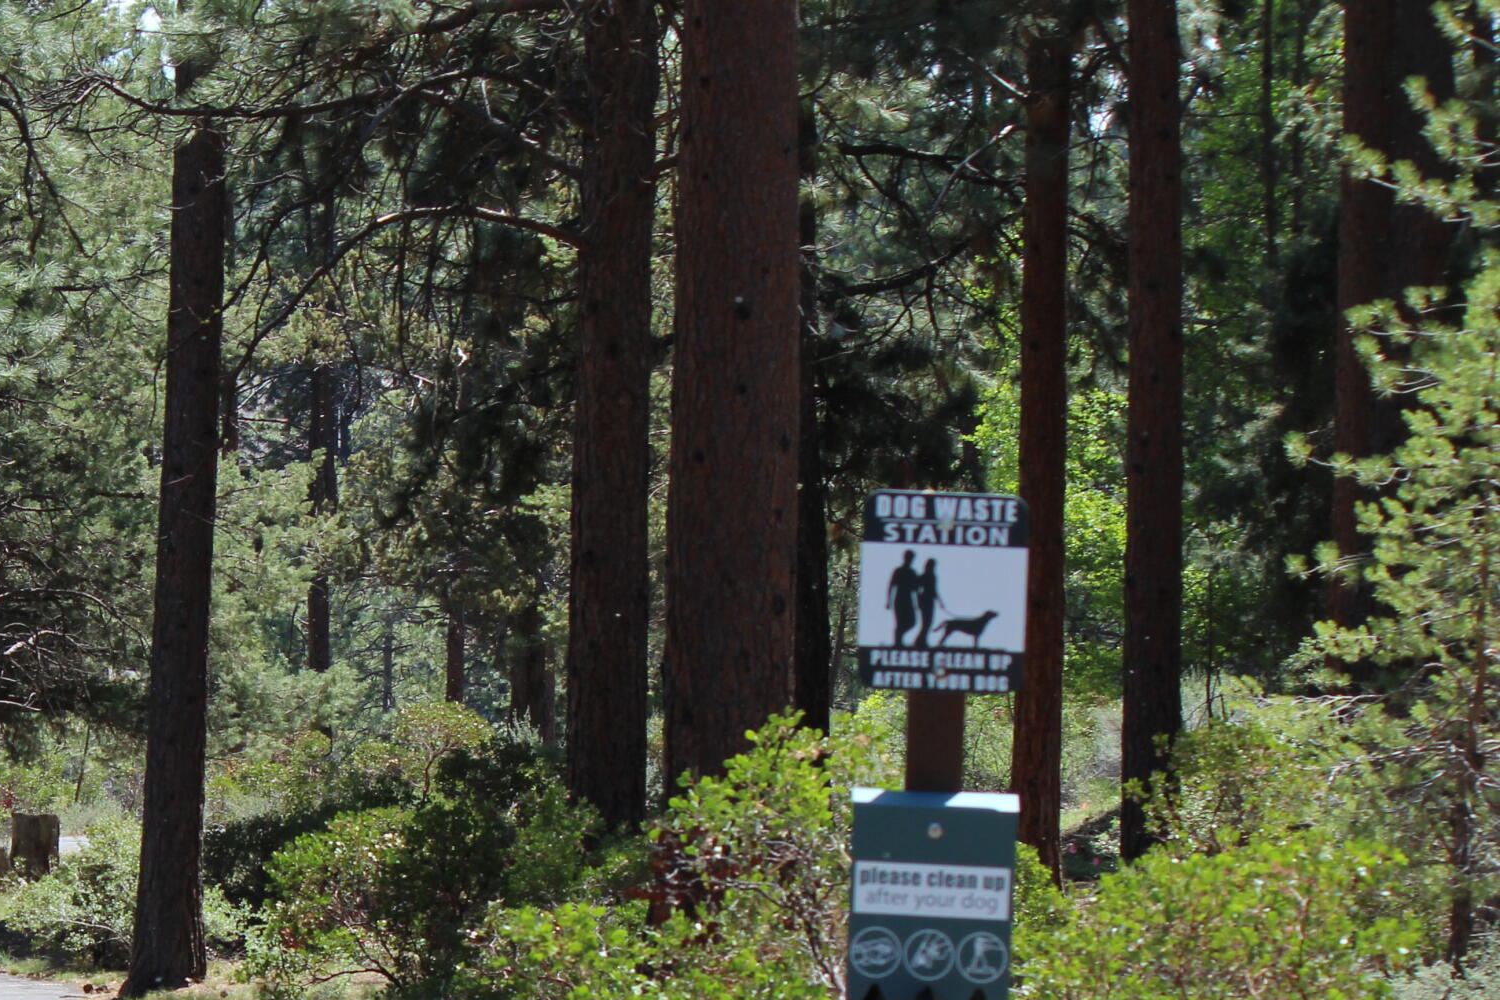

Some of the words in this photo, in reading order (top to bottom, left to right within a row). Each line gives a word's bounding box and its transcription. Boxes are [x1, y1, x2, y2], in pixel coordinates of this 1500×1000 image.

[875, 495, 926, 518] DOG
[933, 498, 1018, 522] WASTE
[883, 523, 1008, 546] STATION
[870, 651, 929, 667] PLEASE
[933, 653, 985, 669] CLEAN
[989, 655, 1012, 670] UP
[872, 670, 923, 688] AFTER
[927, 672, 971, 690] YOUR
[974, 676, 1009, 691] DOG
[859, 867, 922, 887] please
[926, 870, 978, 889] clean
[982, 875, 1005, 892] up
[865, 887, 909, 905] after
[914, 892, 956, 910] your
[960, 892, 1000, 915] dog
